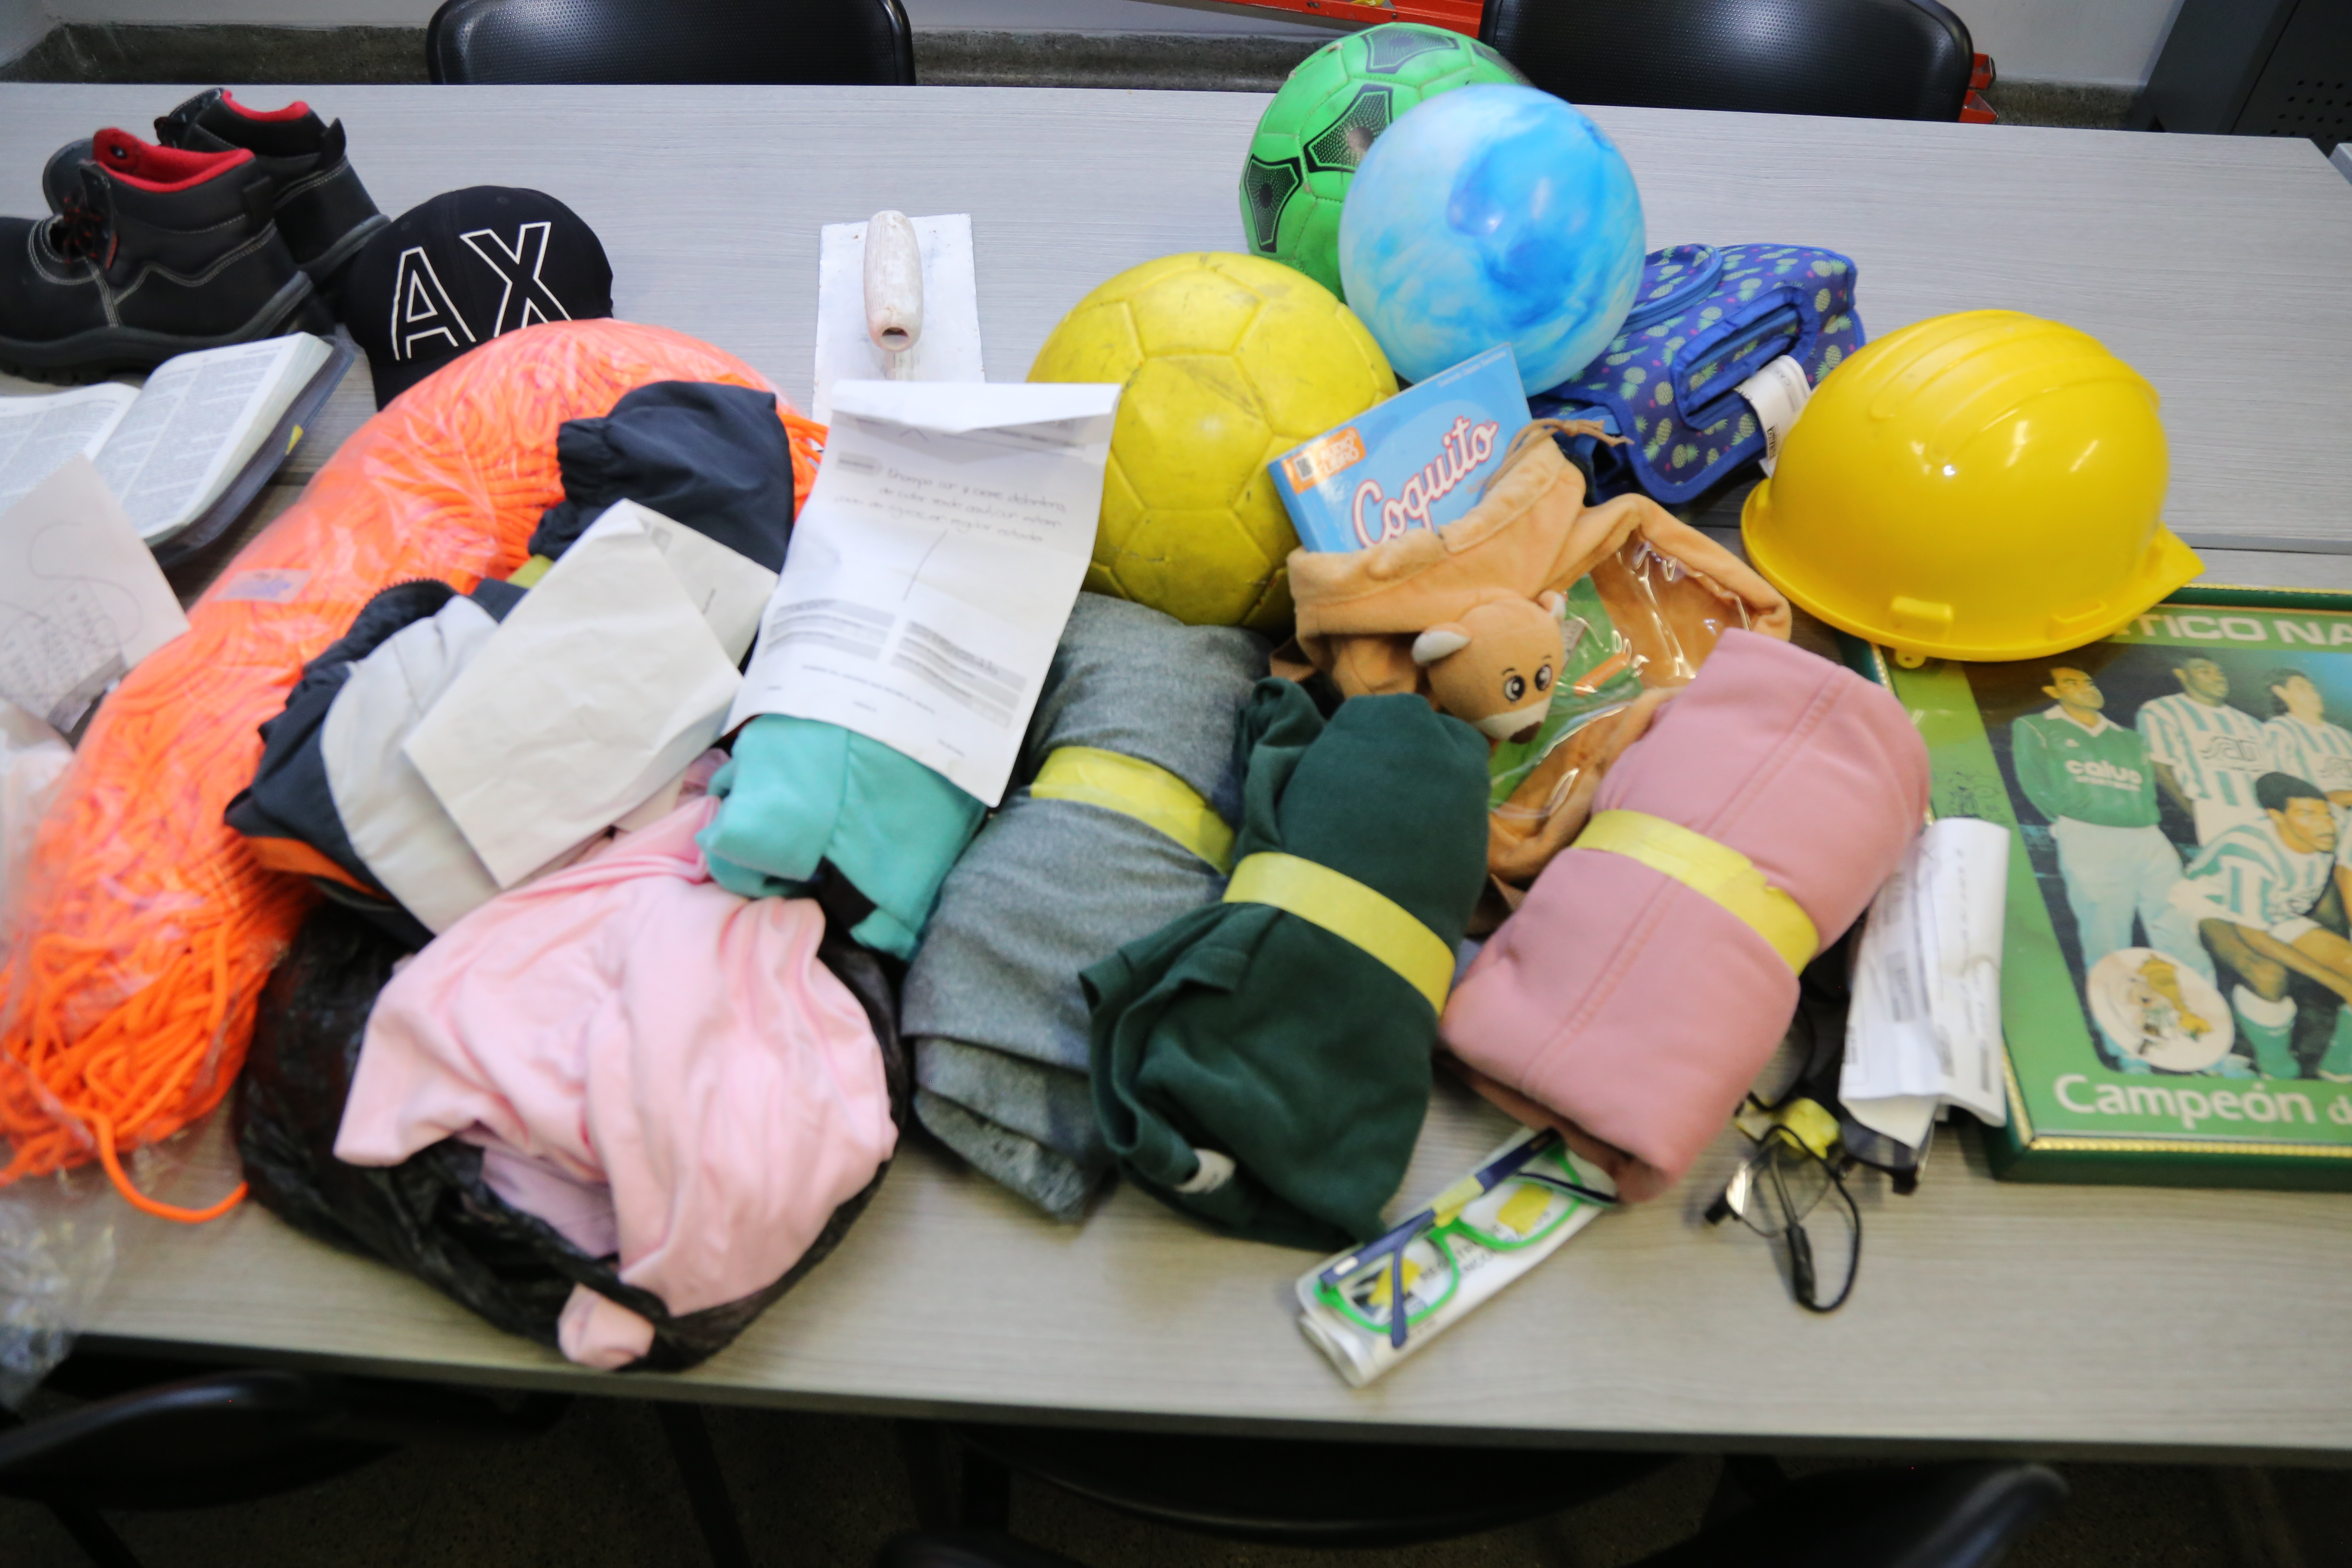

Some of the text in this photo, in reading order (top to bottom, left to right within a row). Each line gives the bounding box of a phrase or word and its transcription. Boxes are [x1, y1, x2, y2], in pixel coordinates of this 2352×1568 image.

[391, 221, 573, 361] AX
[1354, 416, 1499, 548] Coquito
[2115, 613, 2268, 641] TICO
[2053, 1074, 2318, 1130] Campeón
